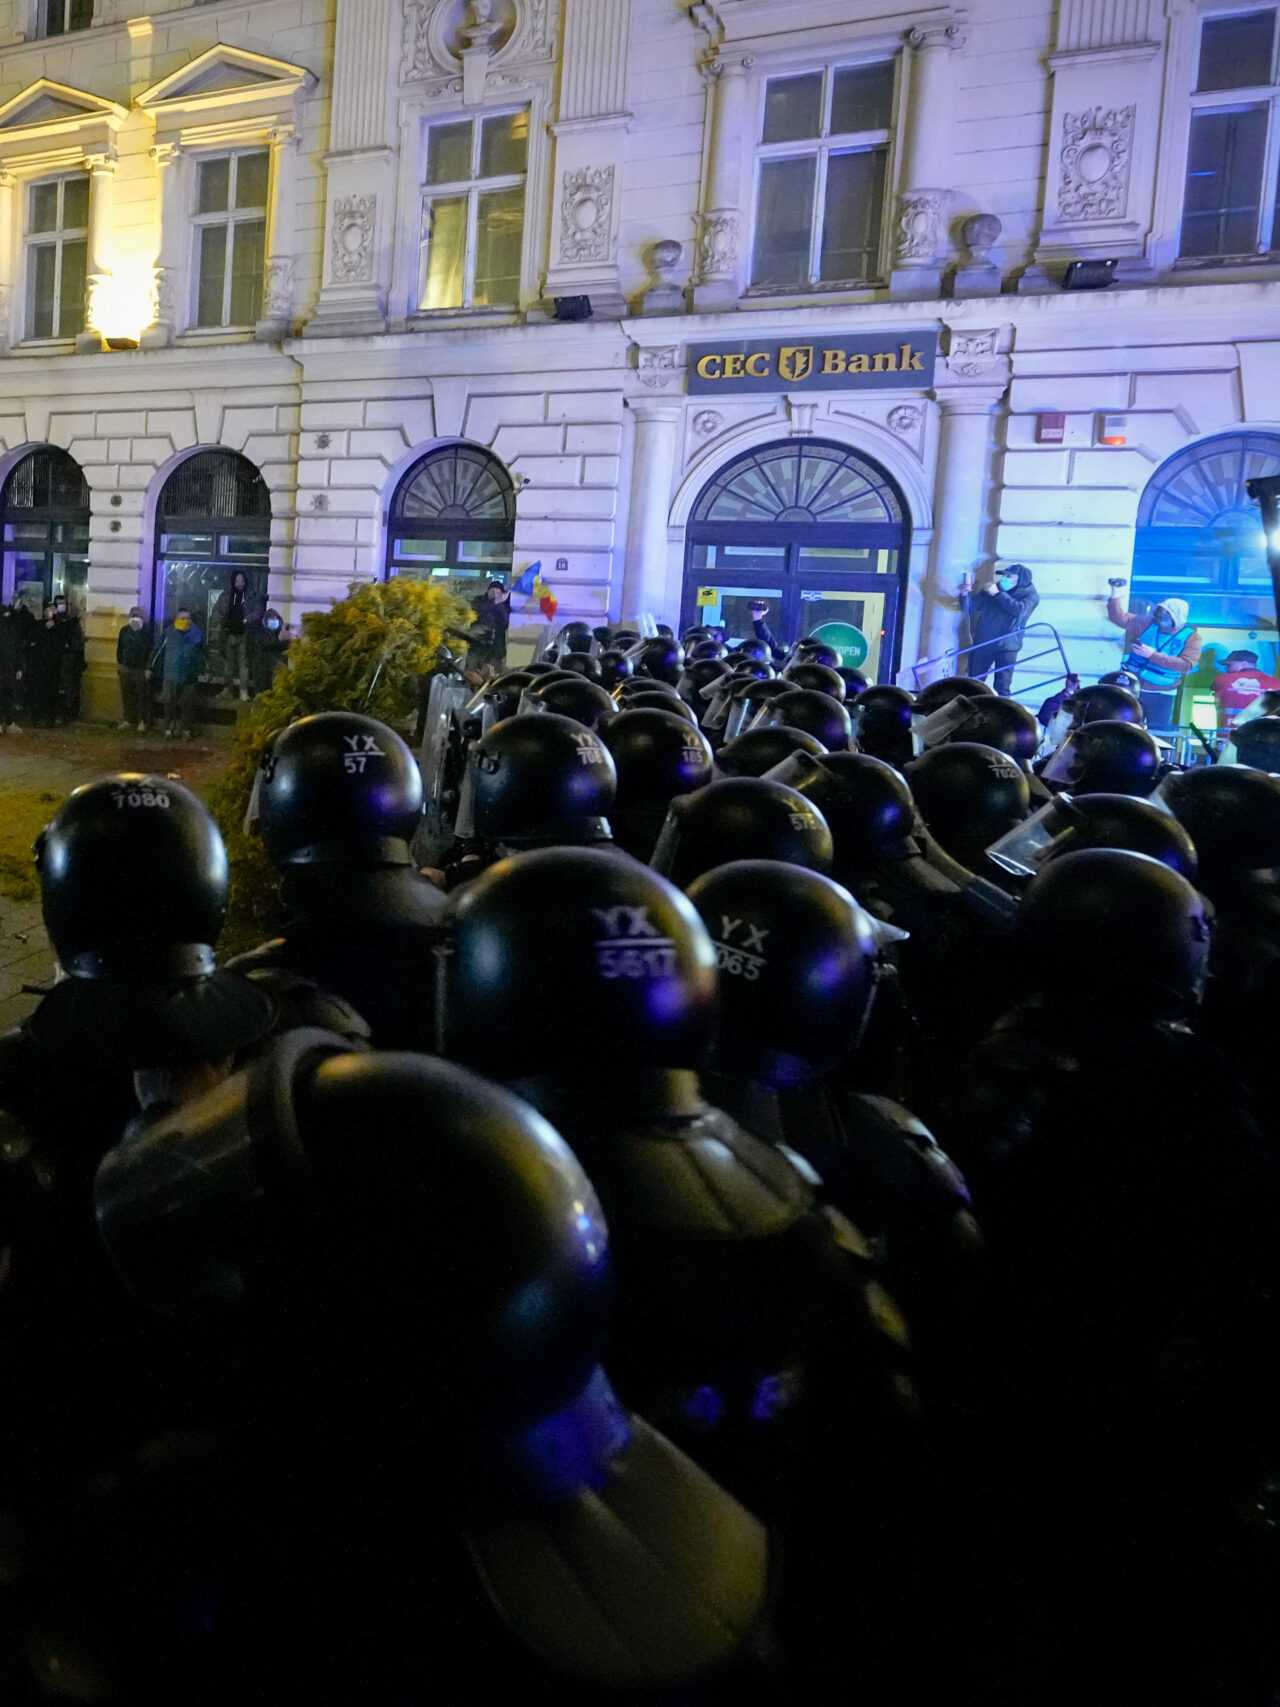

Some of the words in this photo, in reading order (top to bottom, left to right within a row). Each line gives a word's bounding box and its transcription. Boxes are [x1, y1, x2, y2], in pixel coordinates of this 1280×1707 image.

[696, 353, 770, 379] CEC
[821, 344, 925, 374] Bank
[343, 735, 381, 751] YX
[112, 792, 170, 809] 7080
[591, 905, 661, 936] YX
[721, 915, 770, 951] YX
